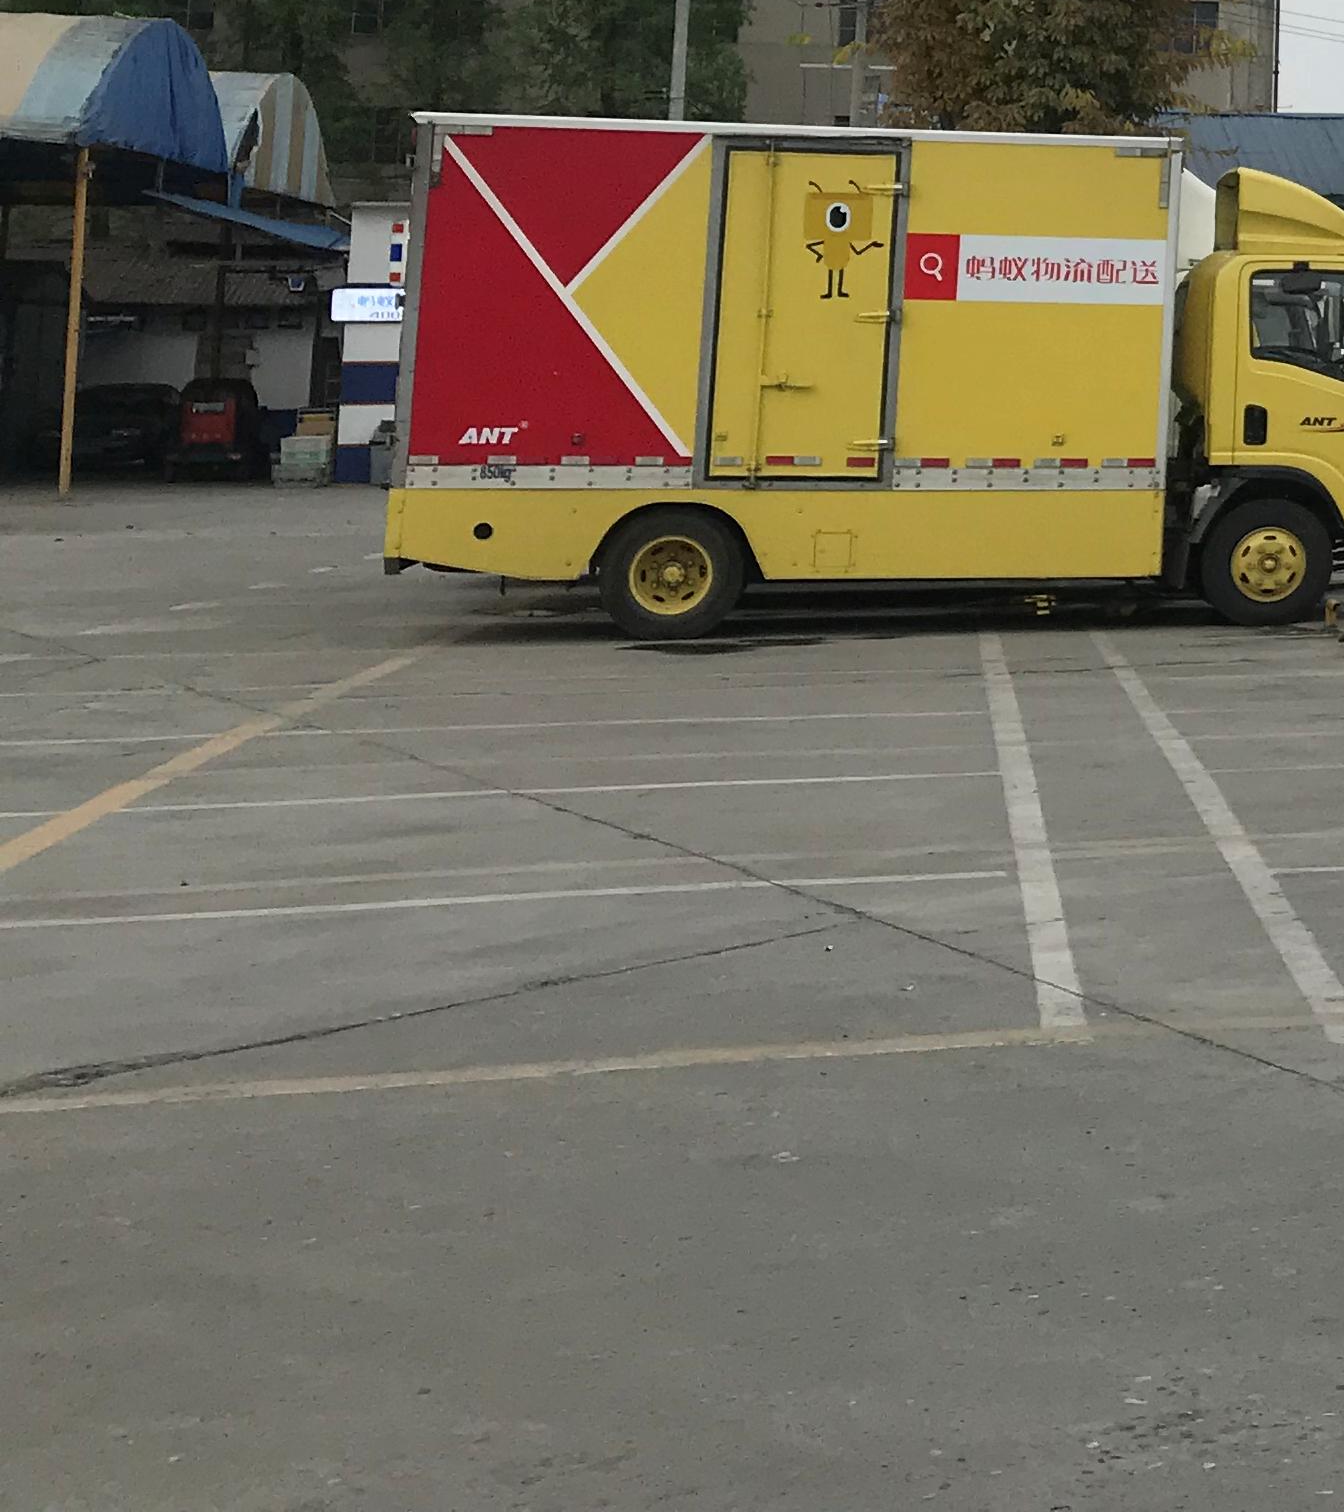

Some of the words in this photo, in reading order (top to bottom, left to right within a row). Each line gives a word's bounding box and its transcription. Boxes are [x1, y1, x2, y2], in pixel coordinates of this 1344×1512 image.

[965, 254, 1160, 286] 蚂蚁物流配送
[1299, 417, 1338, 426] ANT
[458, 427, 519, 445] ANT
